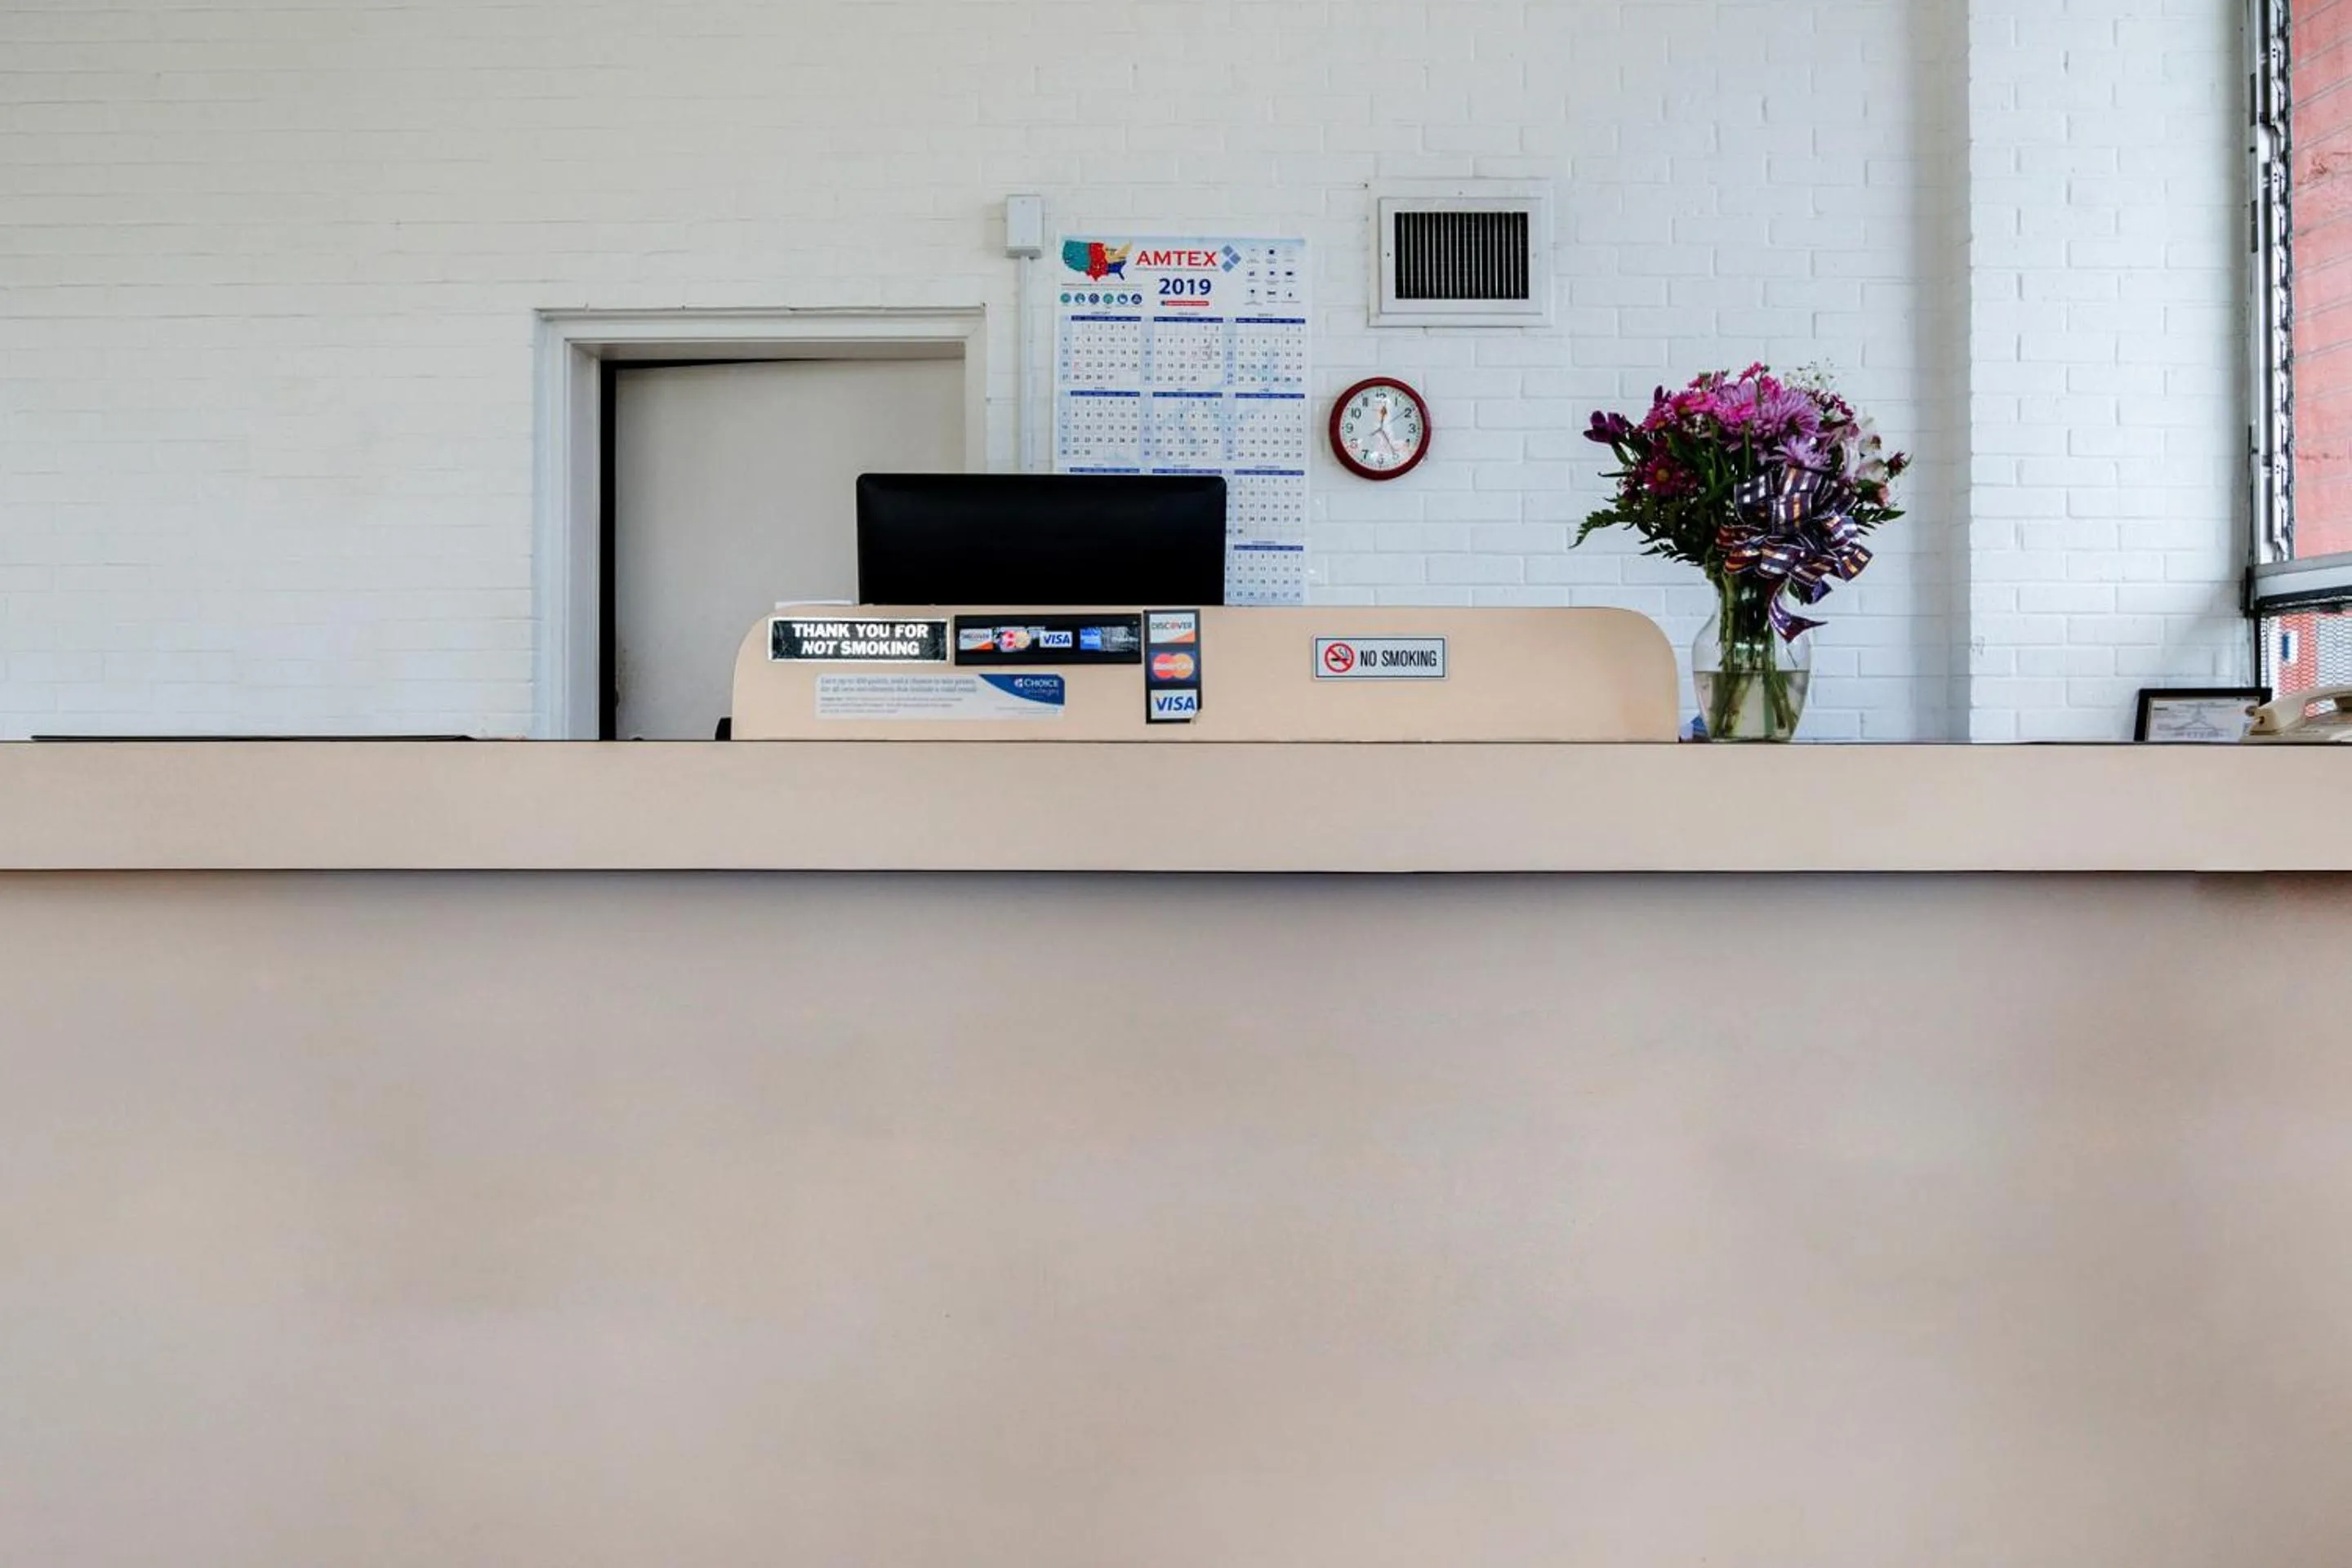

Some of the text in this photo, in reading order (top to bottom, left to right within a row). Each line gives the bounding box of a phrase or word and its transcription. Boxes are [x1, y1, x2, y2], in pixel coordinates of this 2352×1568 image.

[1136, 250, 1217, 266] AMTEX
[1159, 278, 1212, 295] 2019
[1351, 408, 1362, 420] 10
[1404, 408, 1413, 419] 2
[1345, 422, 1354, 434] 9
[1408, 422, 1417, 434] 3
[1361, 449, 1370, 461] 7
[791, 623, 929, 638] THANK YOU FOR
[1042, 633, 1071, 645] VISA
[800, 640, 920, 655] NOT SMOKING
[1360, 650, 1437, 667] NO SMOKING
[1023, 678, 1059, 688] CHOICE
[1155, 696, 1196, 712] VISA
